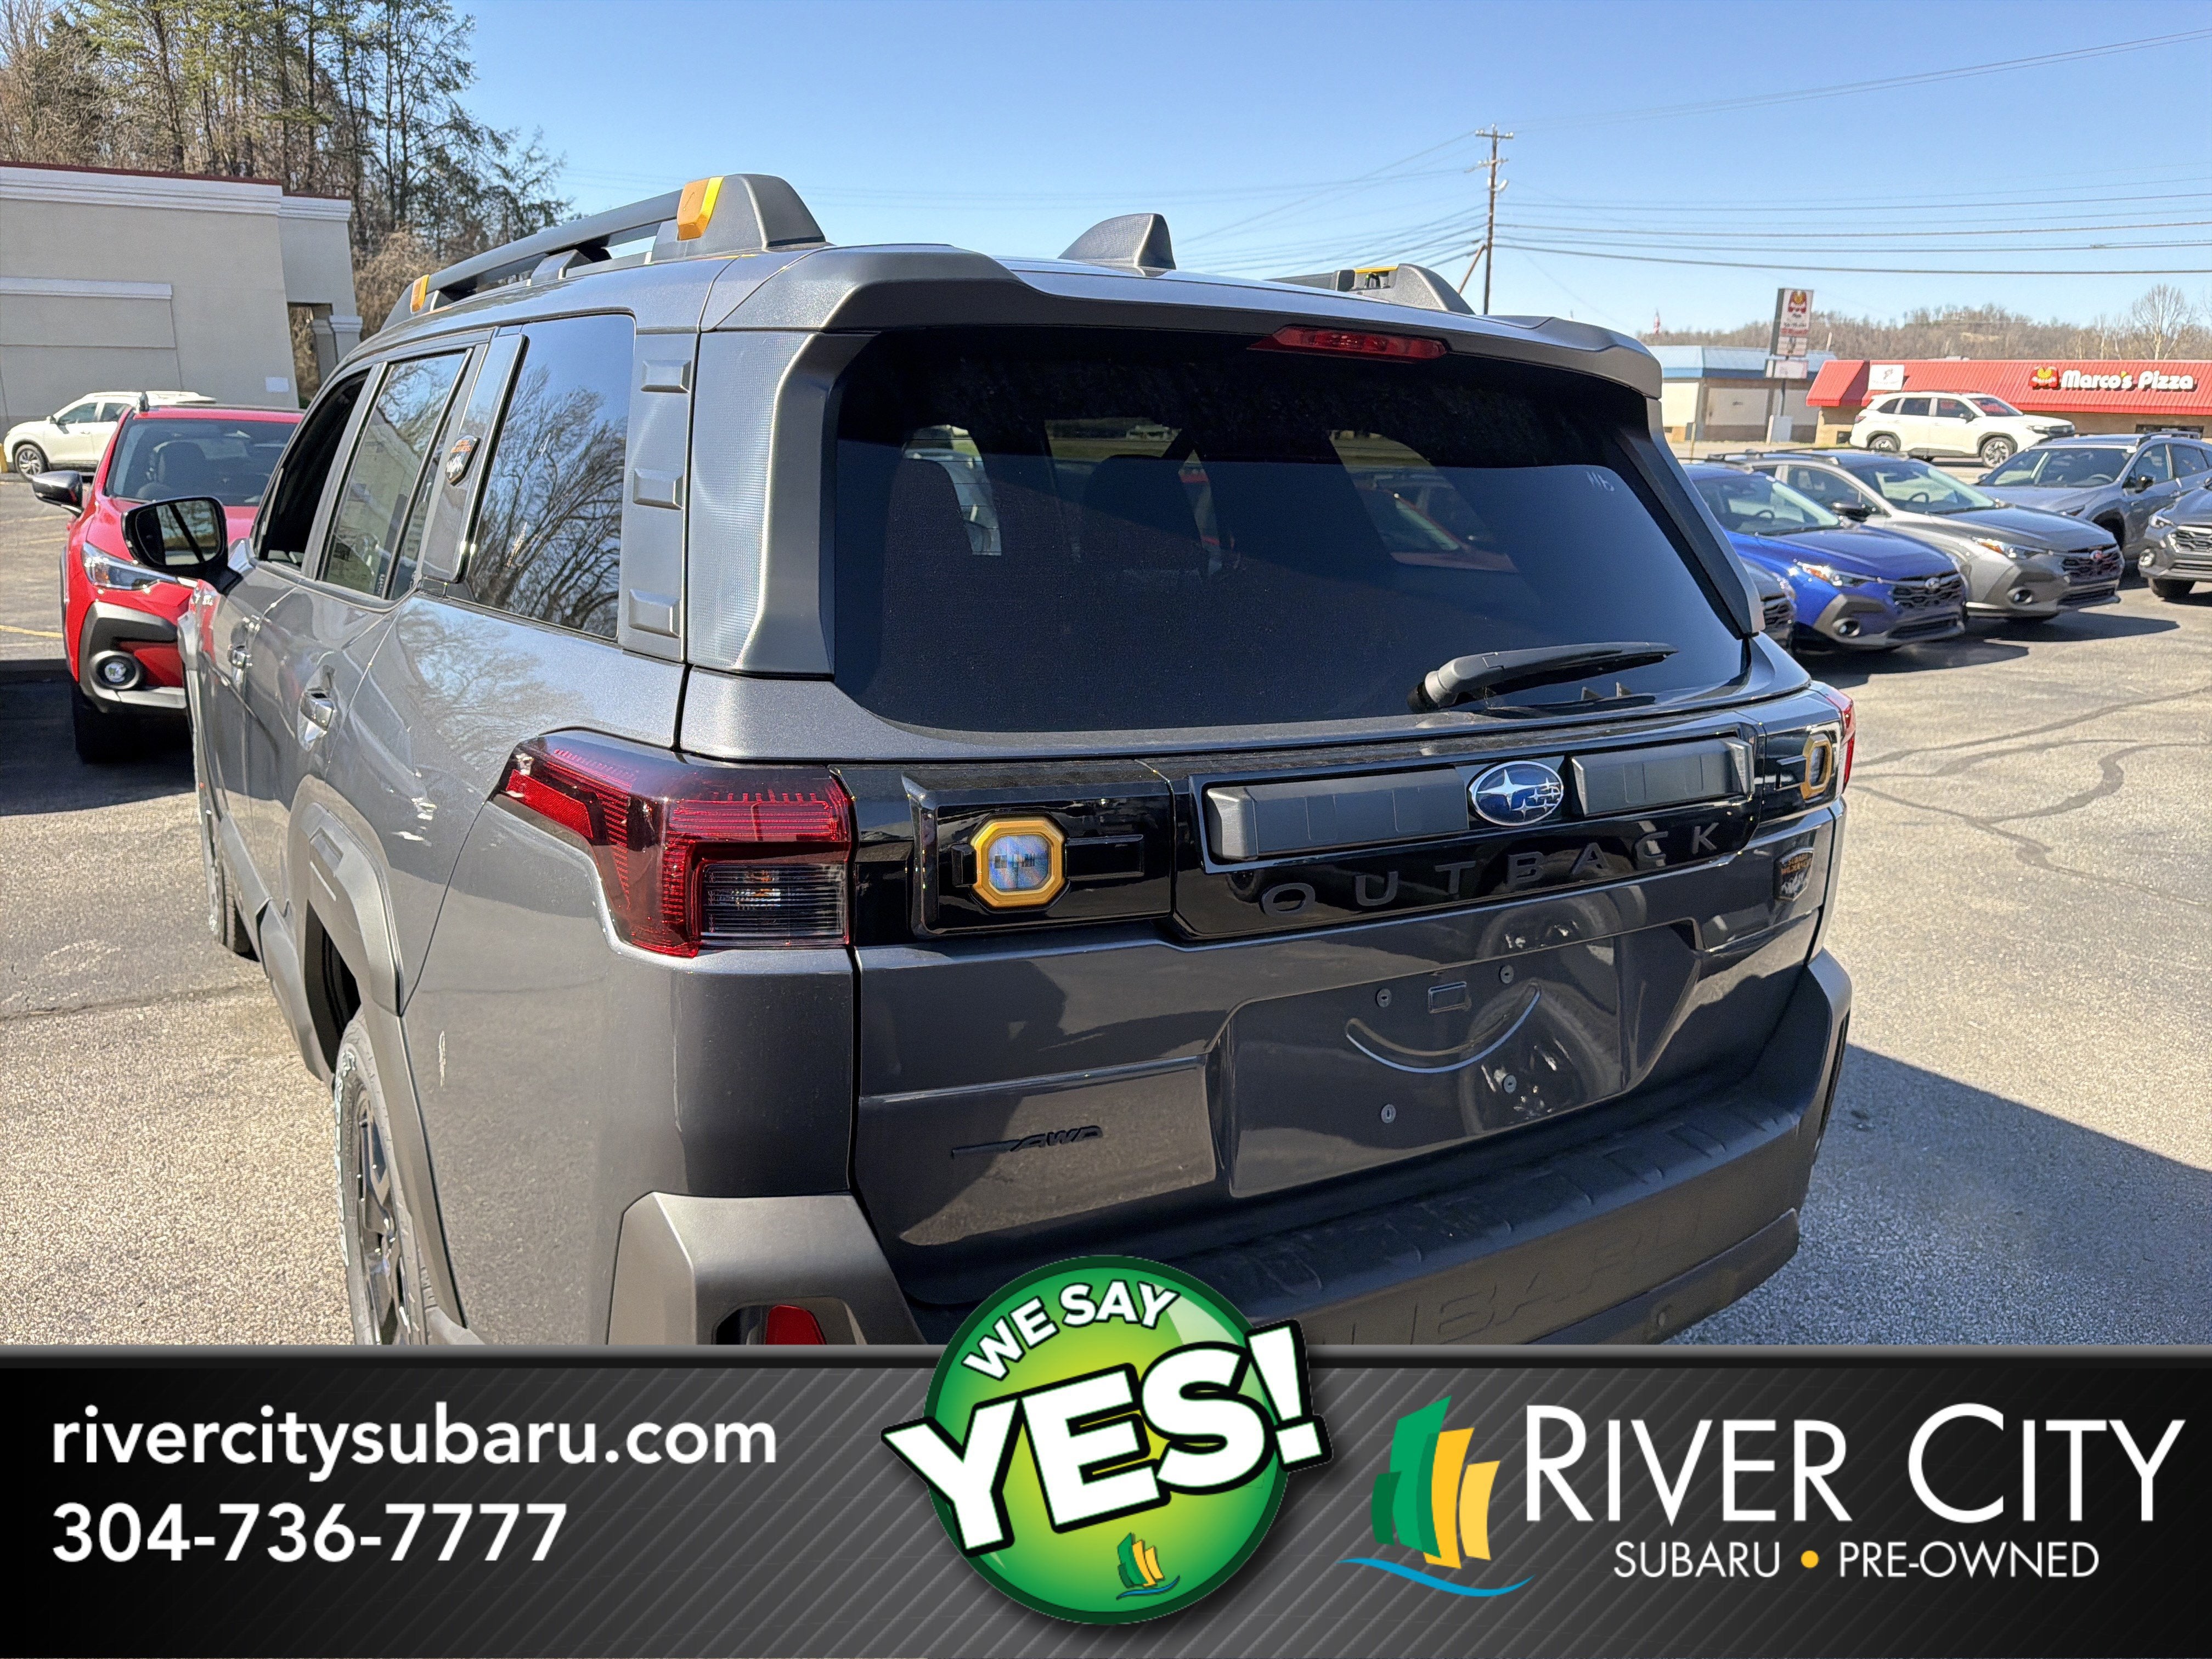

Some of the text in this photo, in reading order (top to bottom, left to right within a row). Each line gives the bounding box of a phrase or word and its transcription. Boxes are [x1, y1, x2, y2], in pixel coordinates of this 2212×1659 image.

[2061, 369, 2133, 389] Marco's
[2137, 369, 2194, 390] Pizza
[1260, 821, 1719, 917] OUTBACK
